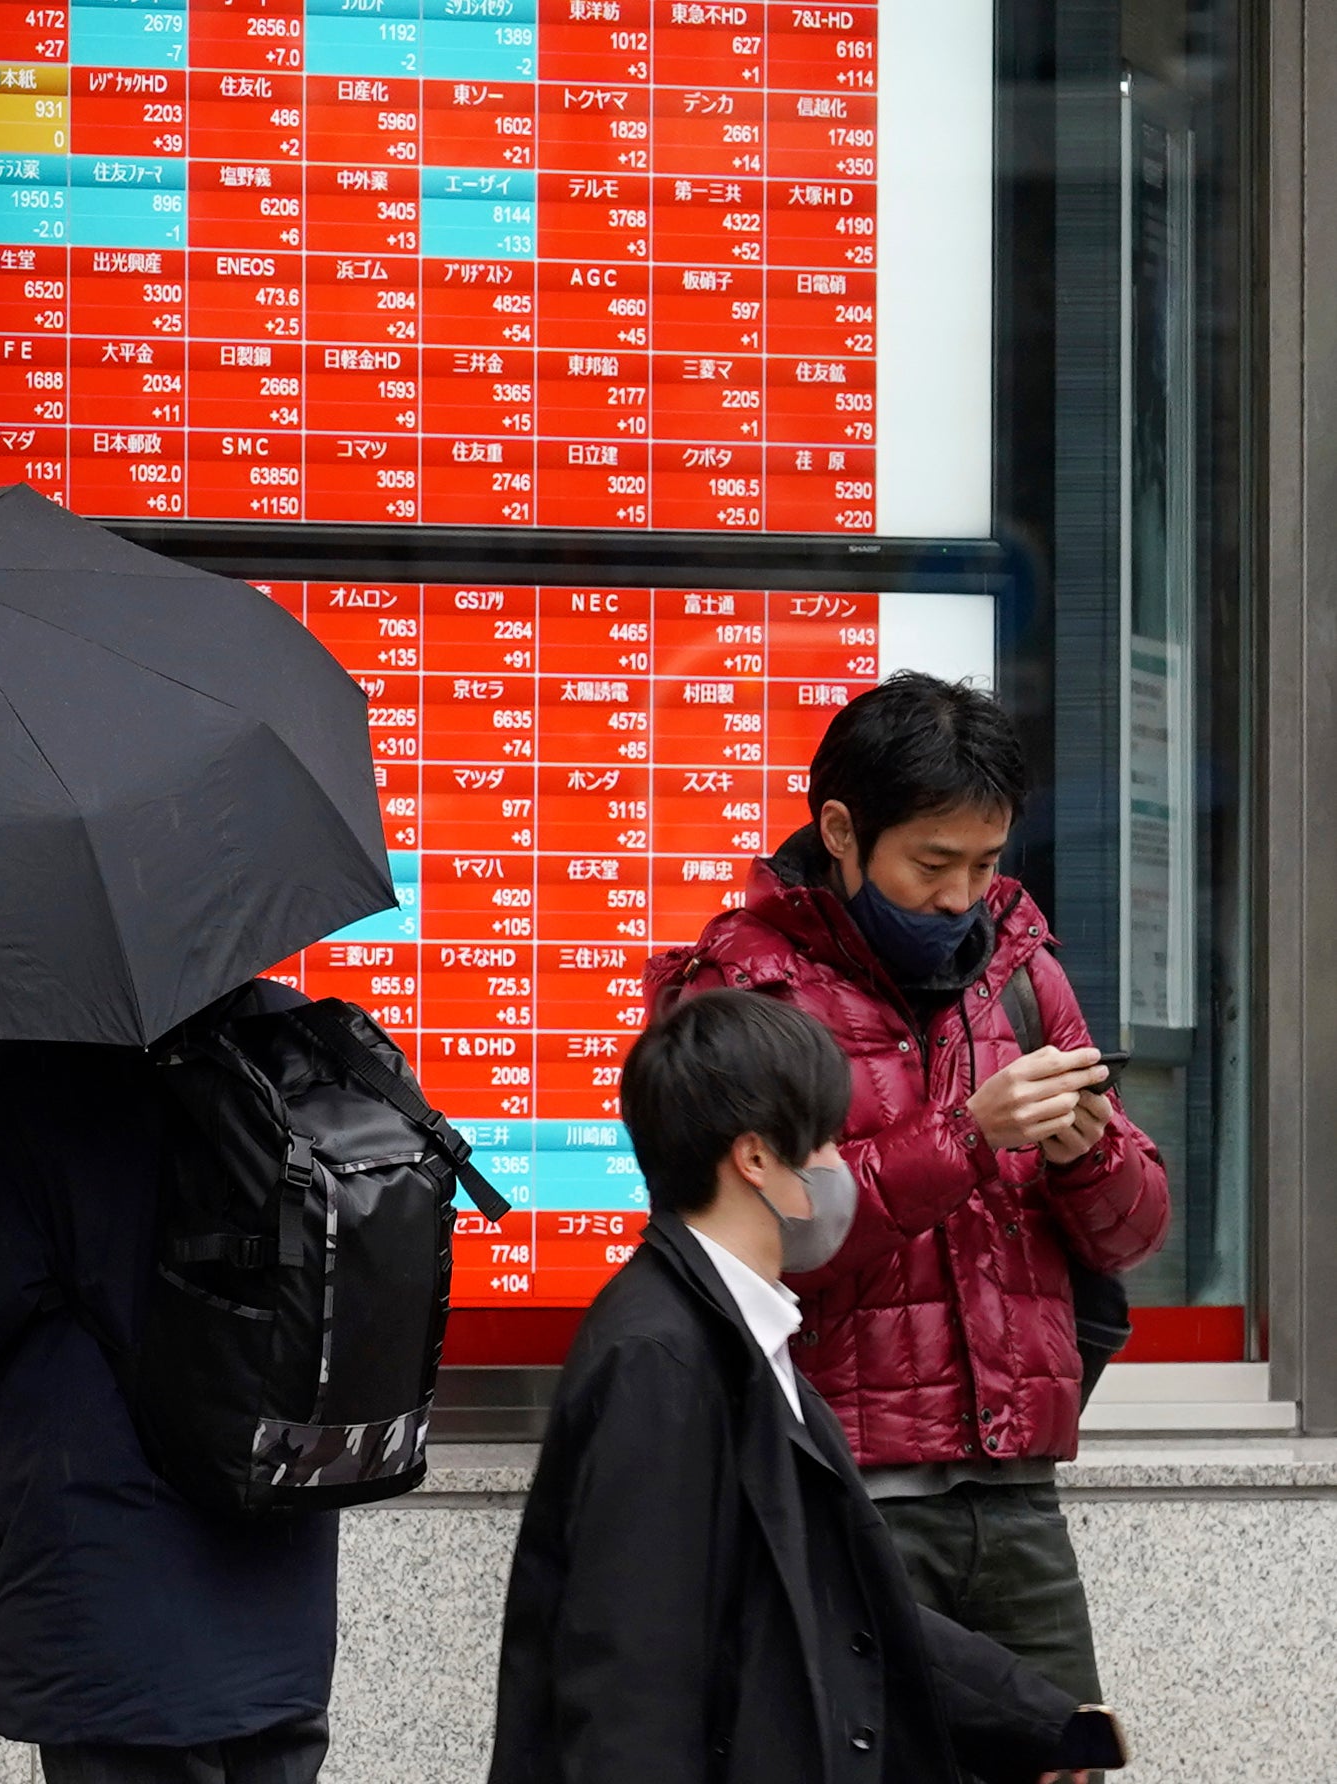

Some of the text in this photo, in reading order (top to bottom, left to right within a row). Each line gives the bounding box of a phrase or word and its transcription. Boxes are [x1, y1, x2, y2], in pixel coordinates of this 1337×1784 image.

[26, 10, 64, 28] 4172
[570, 0, 620, 20] 東洋紡
[672, 3, 747, 25] 東急不HD
[793, 10, 853, 29] 7&I-HD
[837, 41, 872, 58] 6161
[220, 76, 271, 97] 住友化
[684, 92, 733, 114] デンカ
[797, 97, 847, 118] 信越化
[270, 109, 299, 126] 486
[829, 129, 874, 147] 17490
[220, 166, 271, 186] 塩野義
[837, 158, 874, 175] +350
[12, 191, 64, 208] 1950.5
[493, 206, 531, 223] 8144
[94, 252, 161, 273] 出光興産
[217, 257, 275, 276] ENEOS
[25, 281, 63, 299] 6520
[798, 274, 846, 294] 日電硝
[256, 288, 299, 306] 473.6
[102, 343, 153, 363] 大平金
[325, 349, 400, 369] 日軽金HD
[454, 353, 503, 373] 三井金
[26, 371, 63, 389] 1688
[94, 433, 161, 453] 日本郵政
[338, 440, 387, 459] コマツ
[569, 445, 618, 465] 日立建
[683, 447, 732, 467] クボタ
[130, 464, 181, 482] 1092.0
[250, 467, 298, 485] 63850
[709, 479, 759, 496] 1906.5
[836, 481, 872, 499] 5290
[251, 497, 298, 514] +1150
[835, 511, 872, 528] +220
[330, 588, 397, 608] オムロン
[685, 594, 734, 615] 富士通
[790, 595, 856, 617] エプソン
[379, 619, 417, 637] 7063
[494, 621, 532, 639] 2264
[609, 624, 648, 641] 4465
[716, 625, 764, 643] 18715
[839, 628, 875, 645] 1943
[724, 655, 762, 672] +170
[454, 679, 504, 699] 京セラ
[561, 681, 628, 702] 太陽誘電
[684, 683, 734, 703] 村田製
[799, 685, 848, 706] 日東電
[368, 709, 416, 726] 22265
[493, 710, 532, 728] 6635
[609, 712, 650, 731] 4575
[724, 714, 761, 732] 7588
[378, 738, 416, 755] +310
[454, 768, 504, 788] マツダ
[568, 770, 620, 790] ホンダ
[683, 772, 733, 791] スズキ
[386, 798, 415, 816] 492
[503, 799, 531, 817] 977
[722, 803, 761, 820] 4463
[453, 858, 503, 877] ヤマハ
[568, 860, 619, 880] 任天堂
[682, 861, 733, 880] 伊藤忠
[492, 889, 531, 907] 4920
[608, 890, 646, 907] 5578
[330, 946, 393, 966] 三菱UFJ
[441, 947, 516, 967] りそなHD
[371, 977, 415, 995] 955.9
[488, 977, 530, 995] 725.3
[607, 978, 643, 996] 4732
[568, 1037, 617, 1057] 三井不
[492, 1067, 530, 1085] 2008
[592, 1067, 623, 1086] 237
[453, 1126, 509, 1146] 船三井
[567, 1126, 617, 1145] 川崎船
[491, 1156, 530, 1174] 3365
[559, 1215, 623, 1234] コナミG
[491, 1246, 530, 1264] 7748
